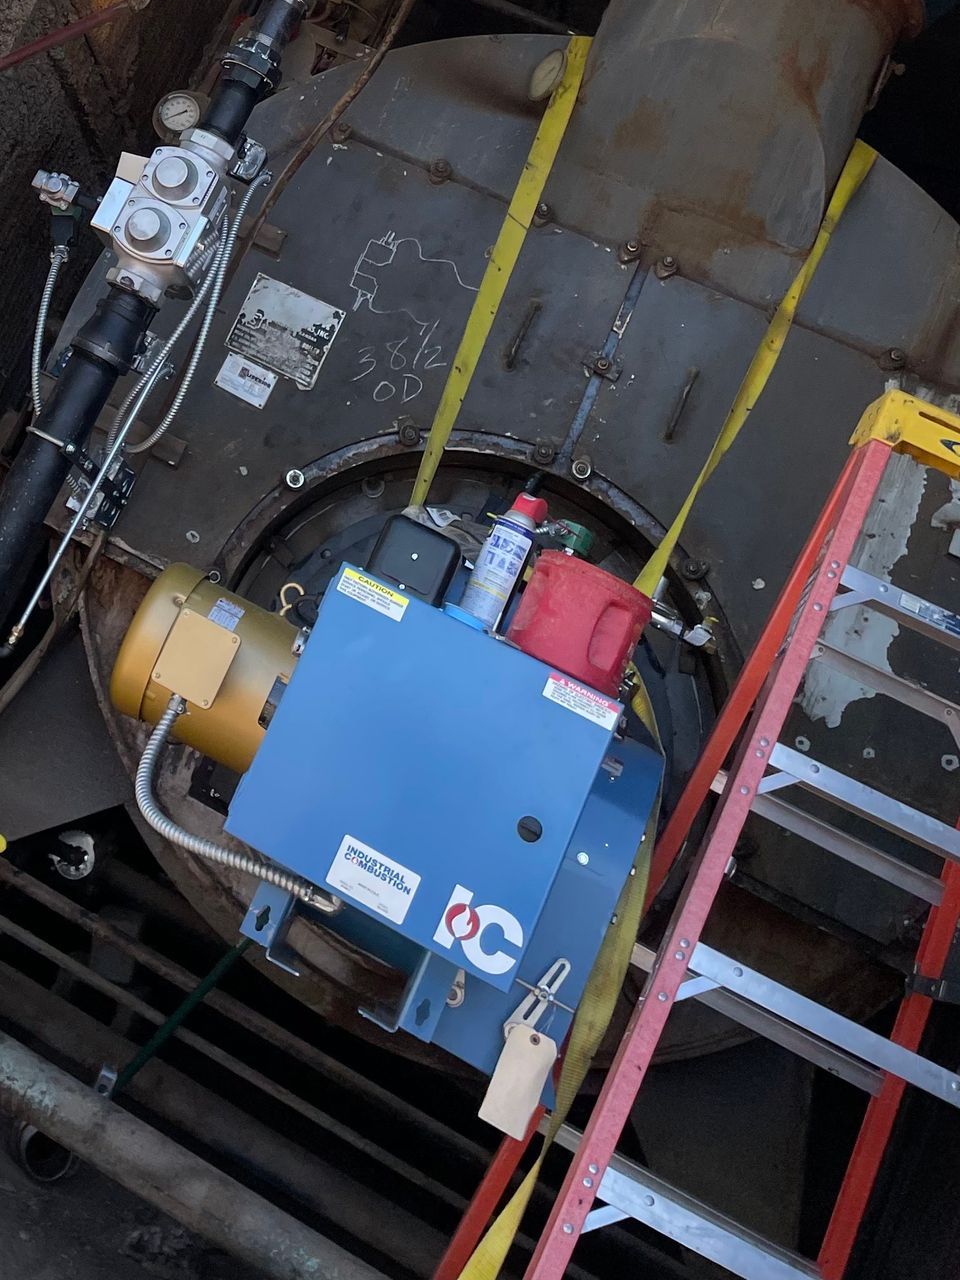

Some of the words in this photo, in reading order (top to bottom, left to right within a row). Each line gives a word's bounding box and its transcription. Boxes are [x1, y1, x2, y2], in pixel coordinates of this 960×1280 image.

[358, 576, 394, 597] CAUTION
[566, 681, 609, 707] WARNING
[344, 852, 412, 896] COMBUSTION
[346, 844, 406, 885] INDUSTRIAL
